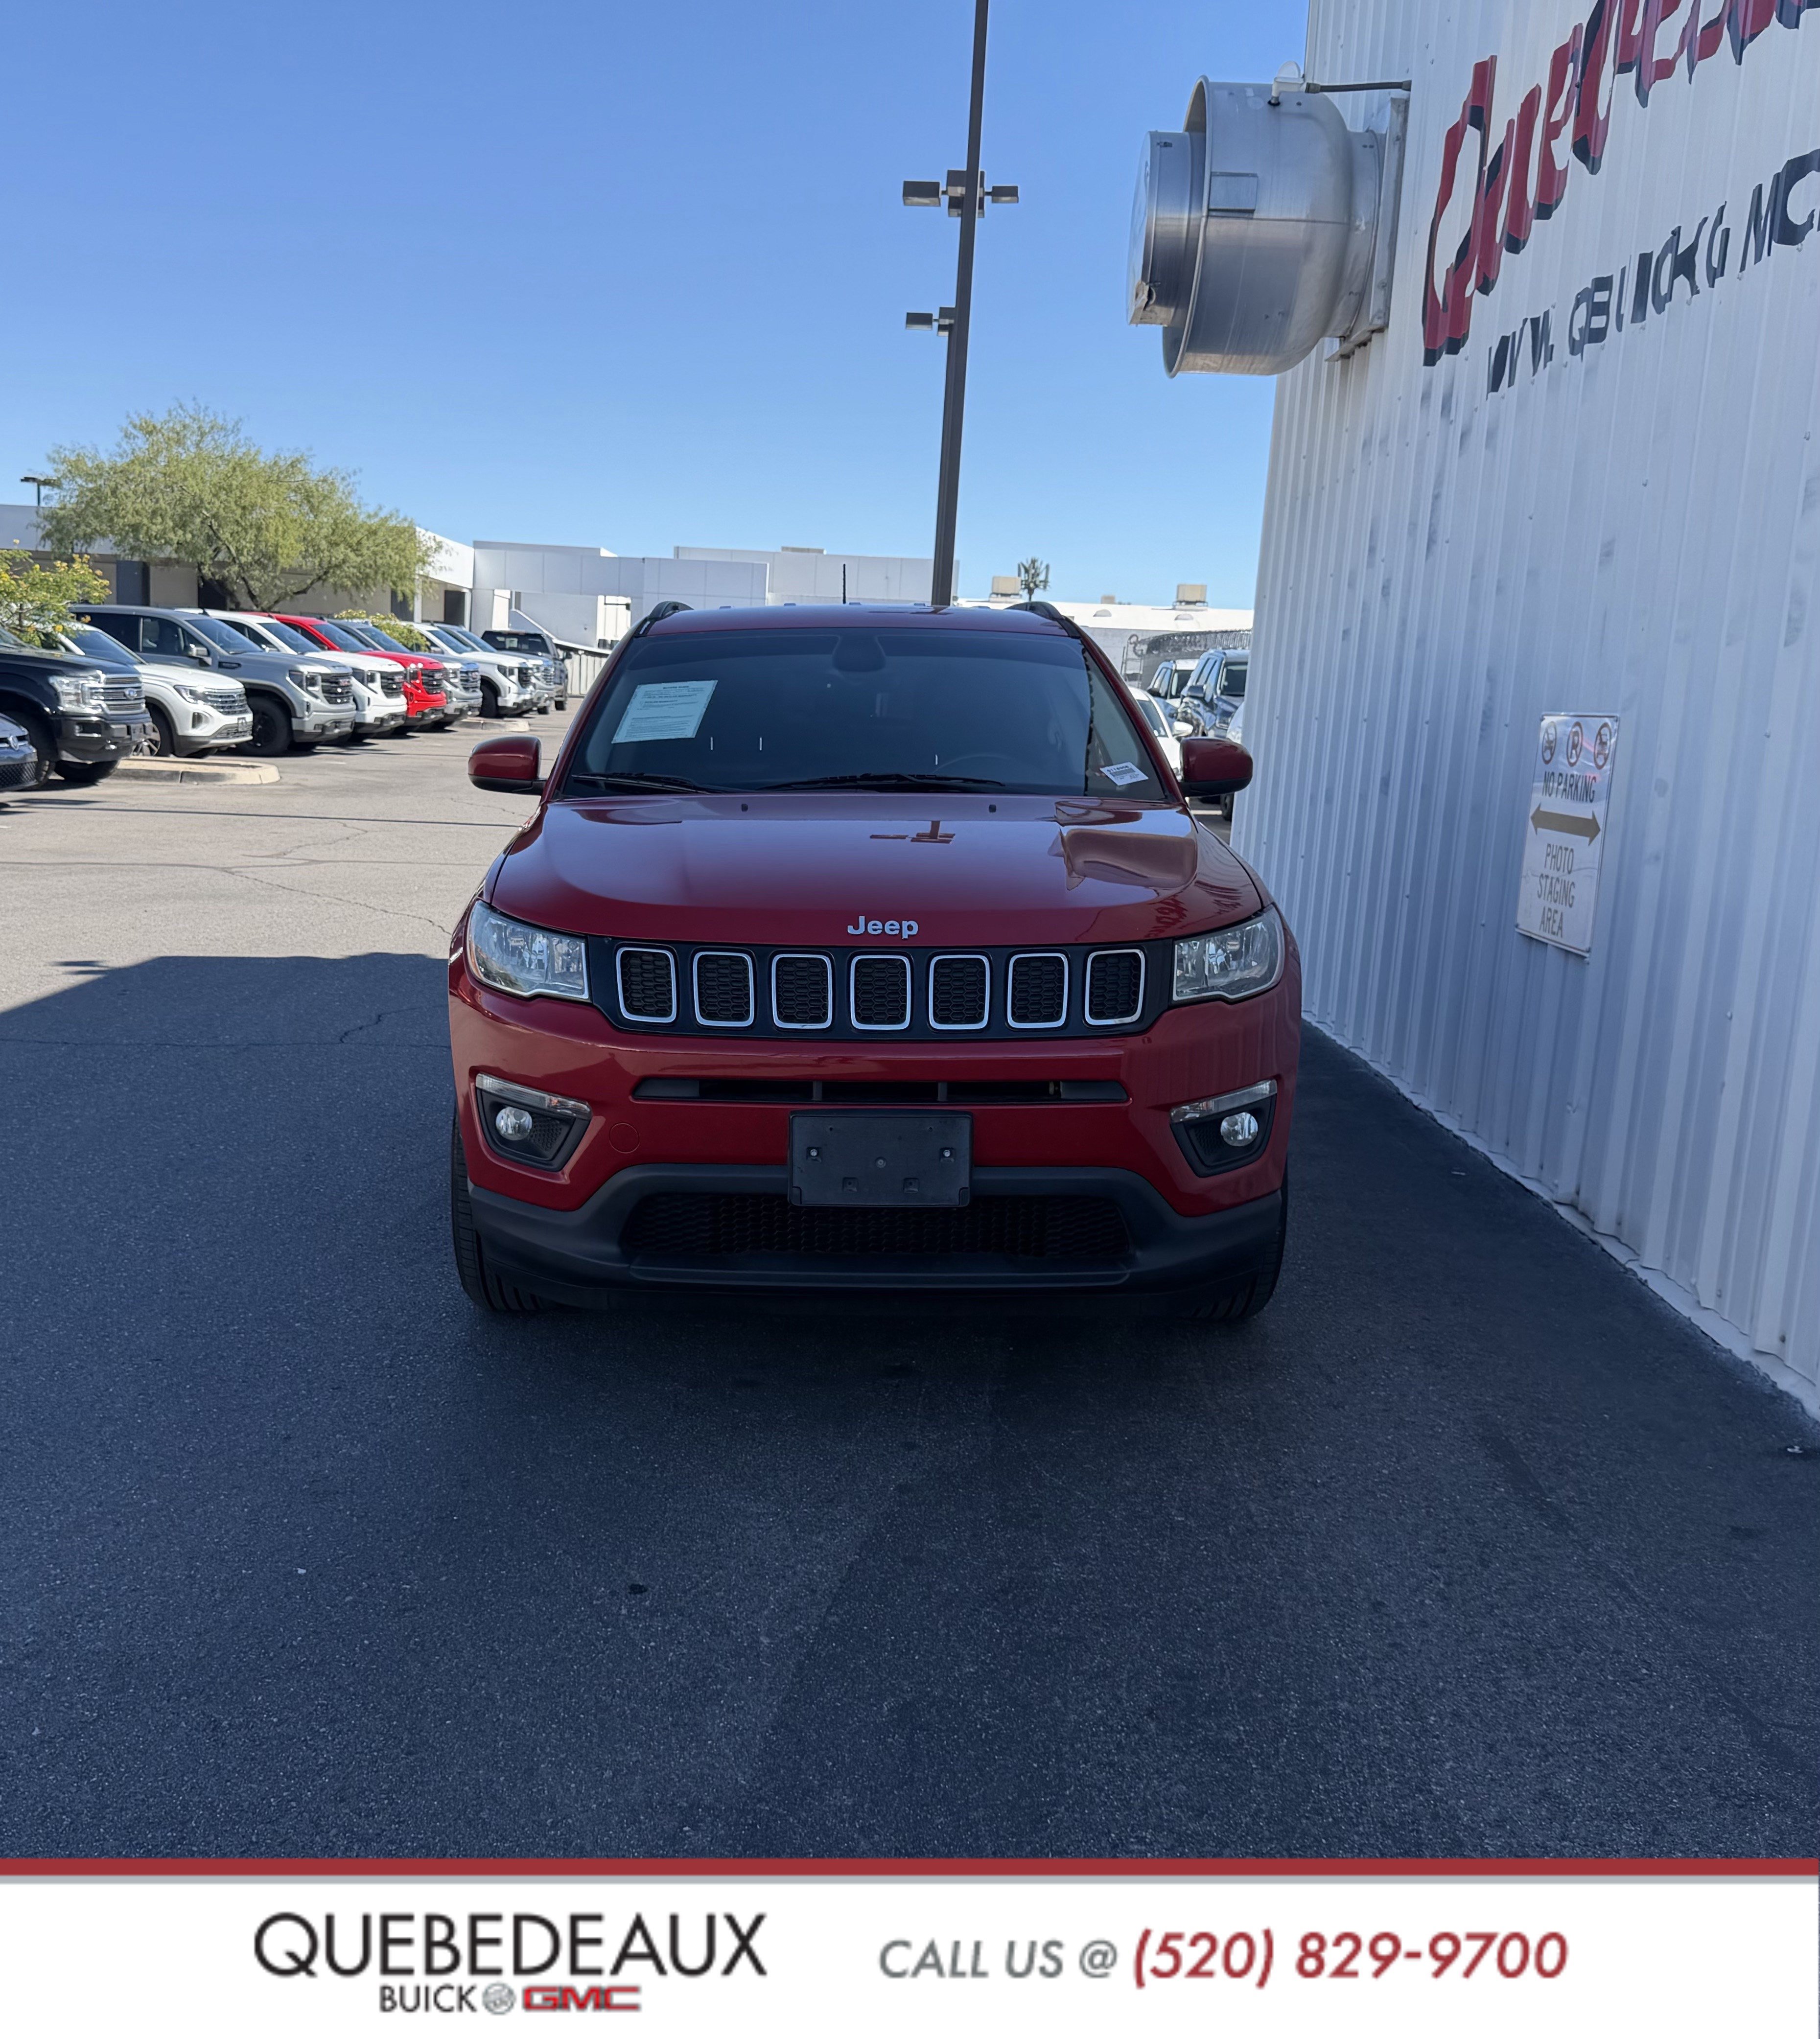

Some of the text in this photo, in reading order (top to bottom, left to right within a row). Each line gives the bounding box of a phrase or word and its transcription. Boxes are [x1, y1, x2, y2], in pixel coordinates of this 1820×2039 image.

[1542, 770, 1597, 803] NO PARKING
[1544, 843, 1574, 875] PHOTO
[1537, 873, 1575, 908] STAGING
[847, 915, 918, 939] Jeep
[1539, 906, 1563, 938] AREA
